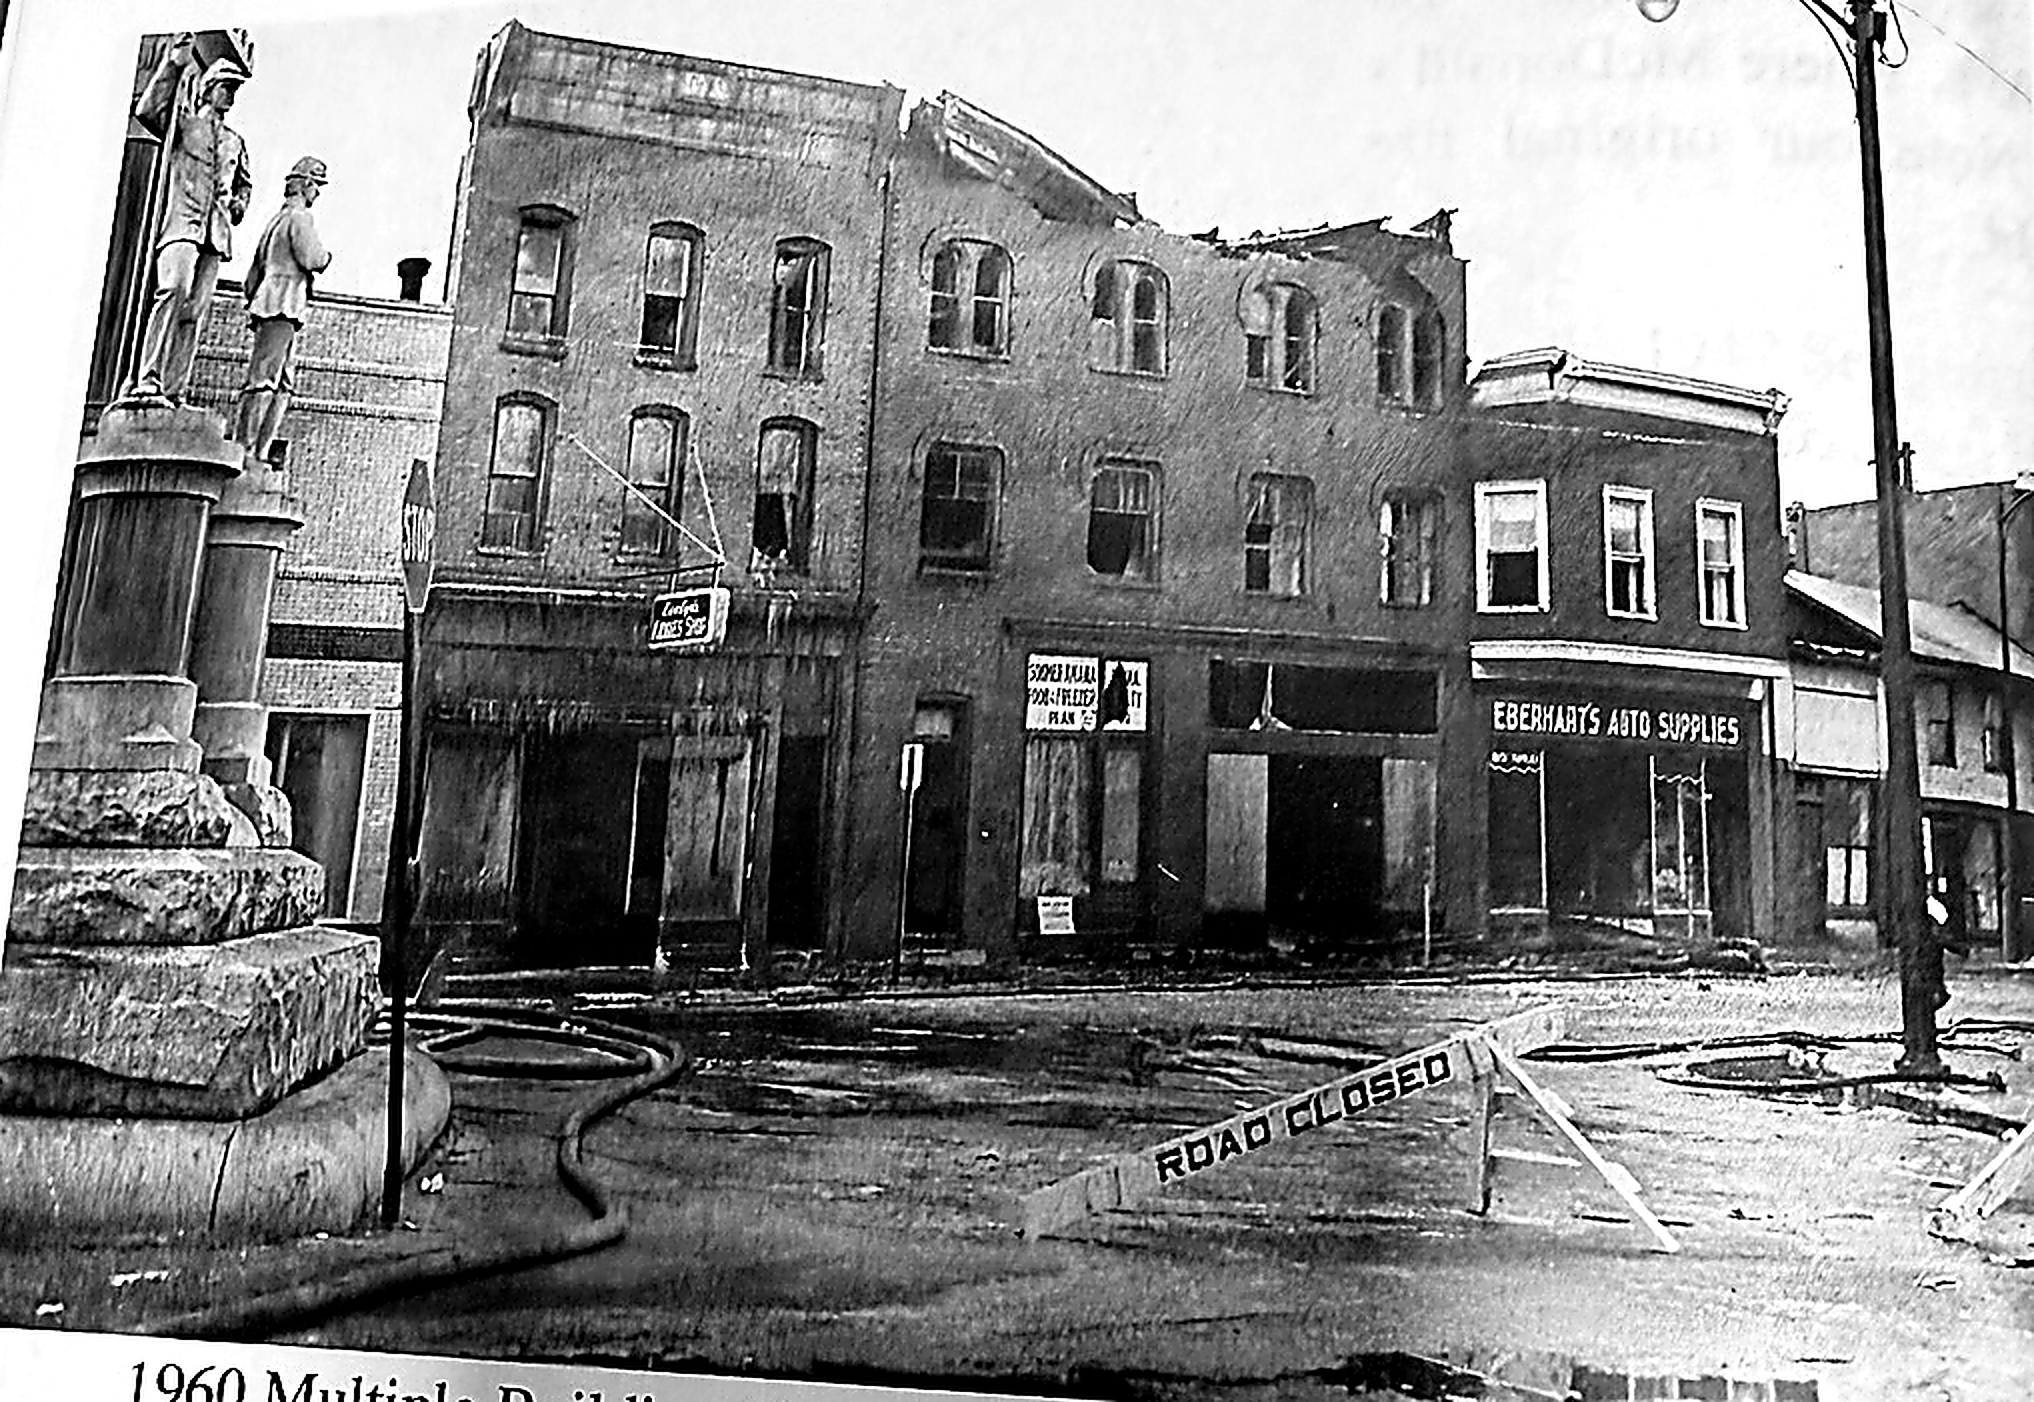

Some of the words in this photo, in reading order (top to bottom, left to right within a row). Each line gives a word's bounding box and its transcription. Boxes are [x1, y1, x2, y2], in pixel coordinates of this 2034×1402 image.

[403, 503, 435, 562] STOP
[1493, 701, 1600, 735] EBERHART'S
[1607, 708, 1651, 739] AUTO
[1658, 711, 1740, 745] SUPPLIES
[1155, 1114, 1272, 1183] ROAD
[1285, 1050, 1452, 1137] CLOSED
[132, 1361, 247, 1402] 1960
